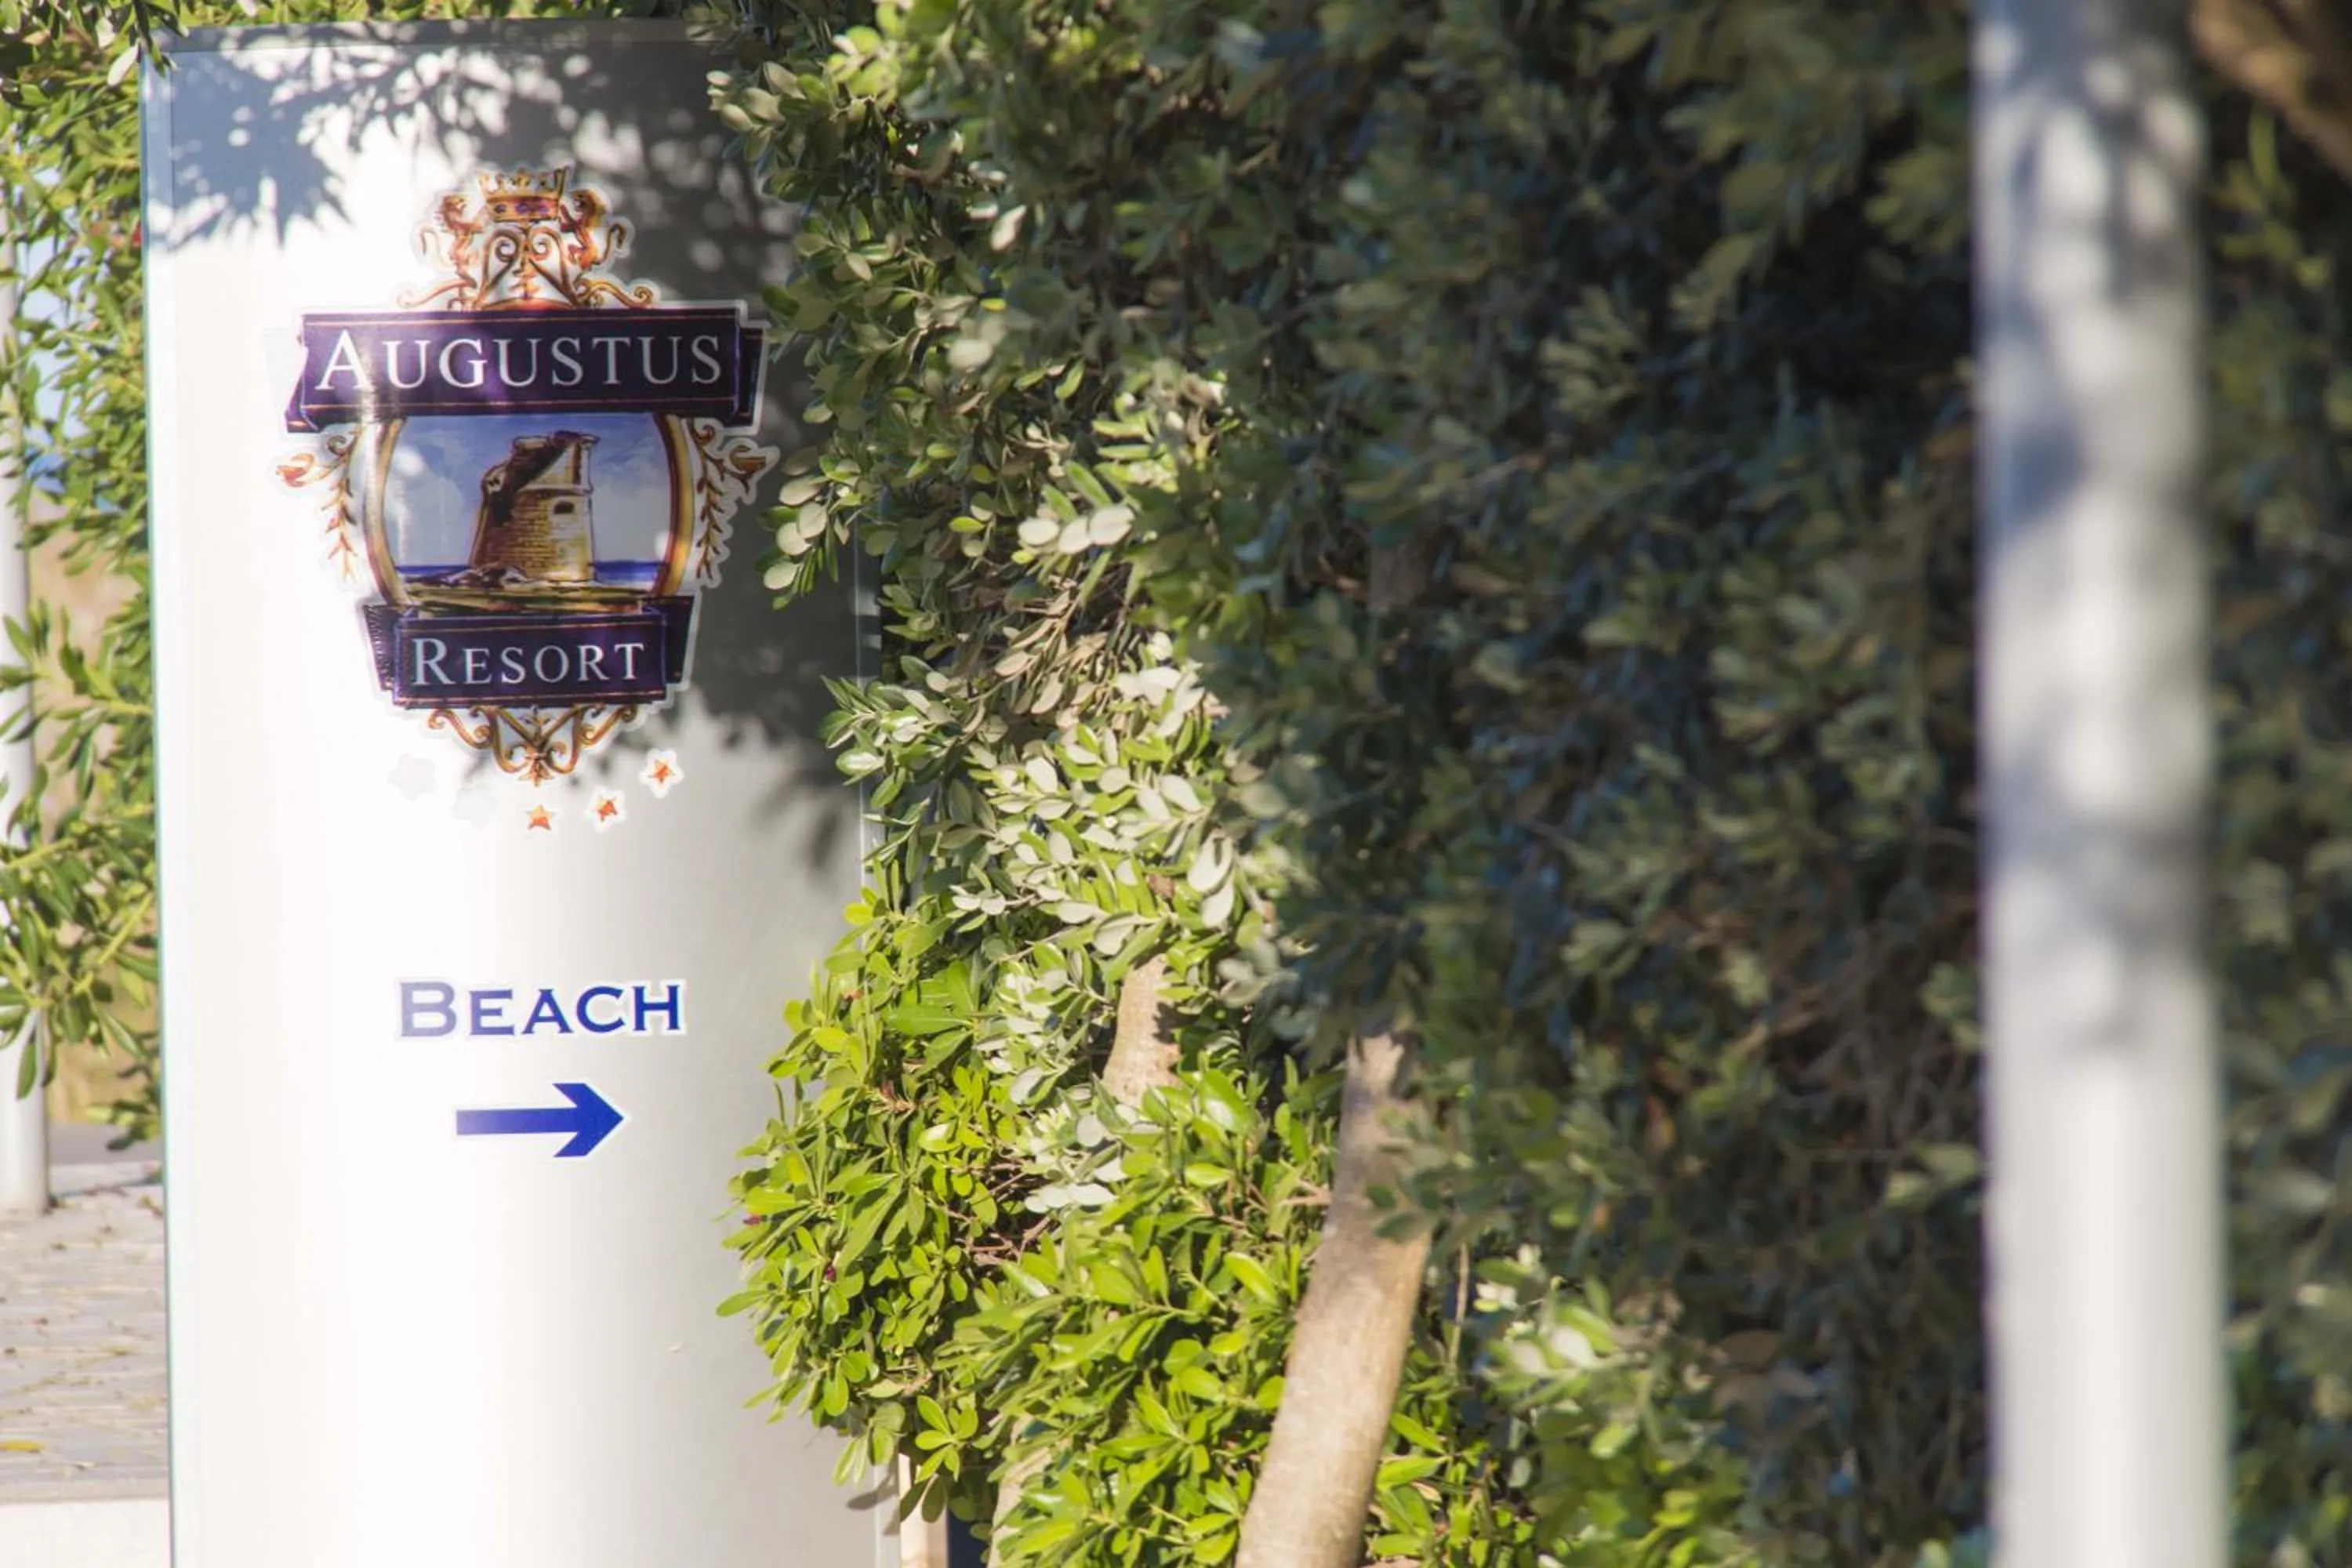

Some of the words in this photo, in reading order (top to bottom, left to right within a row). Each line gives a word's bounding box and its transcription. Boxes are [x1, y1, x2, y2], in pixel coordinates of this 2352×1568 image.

[314, 328, 722, 390] AUGUSTUS
[412, 637, 644, 685] RESORT
[400, 982, 681, 1037] BEACH
